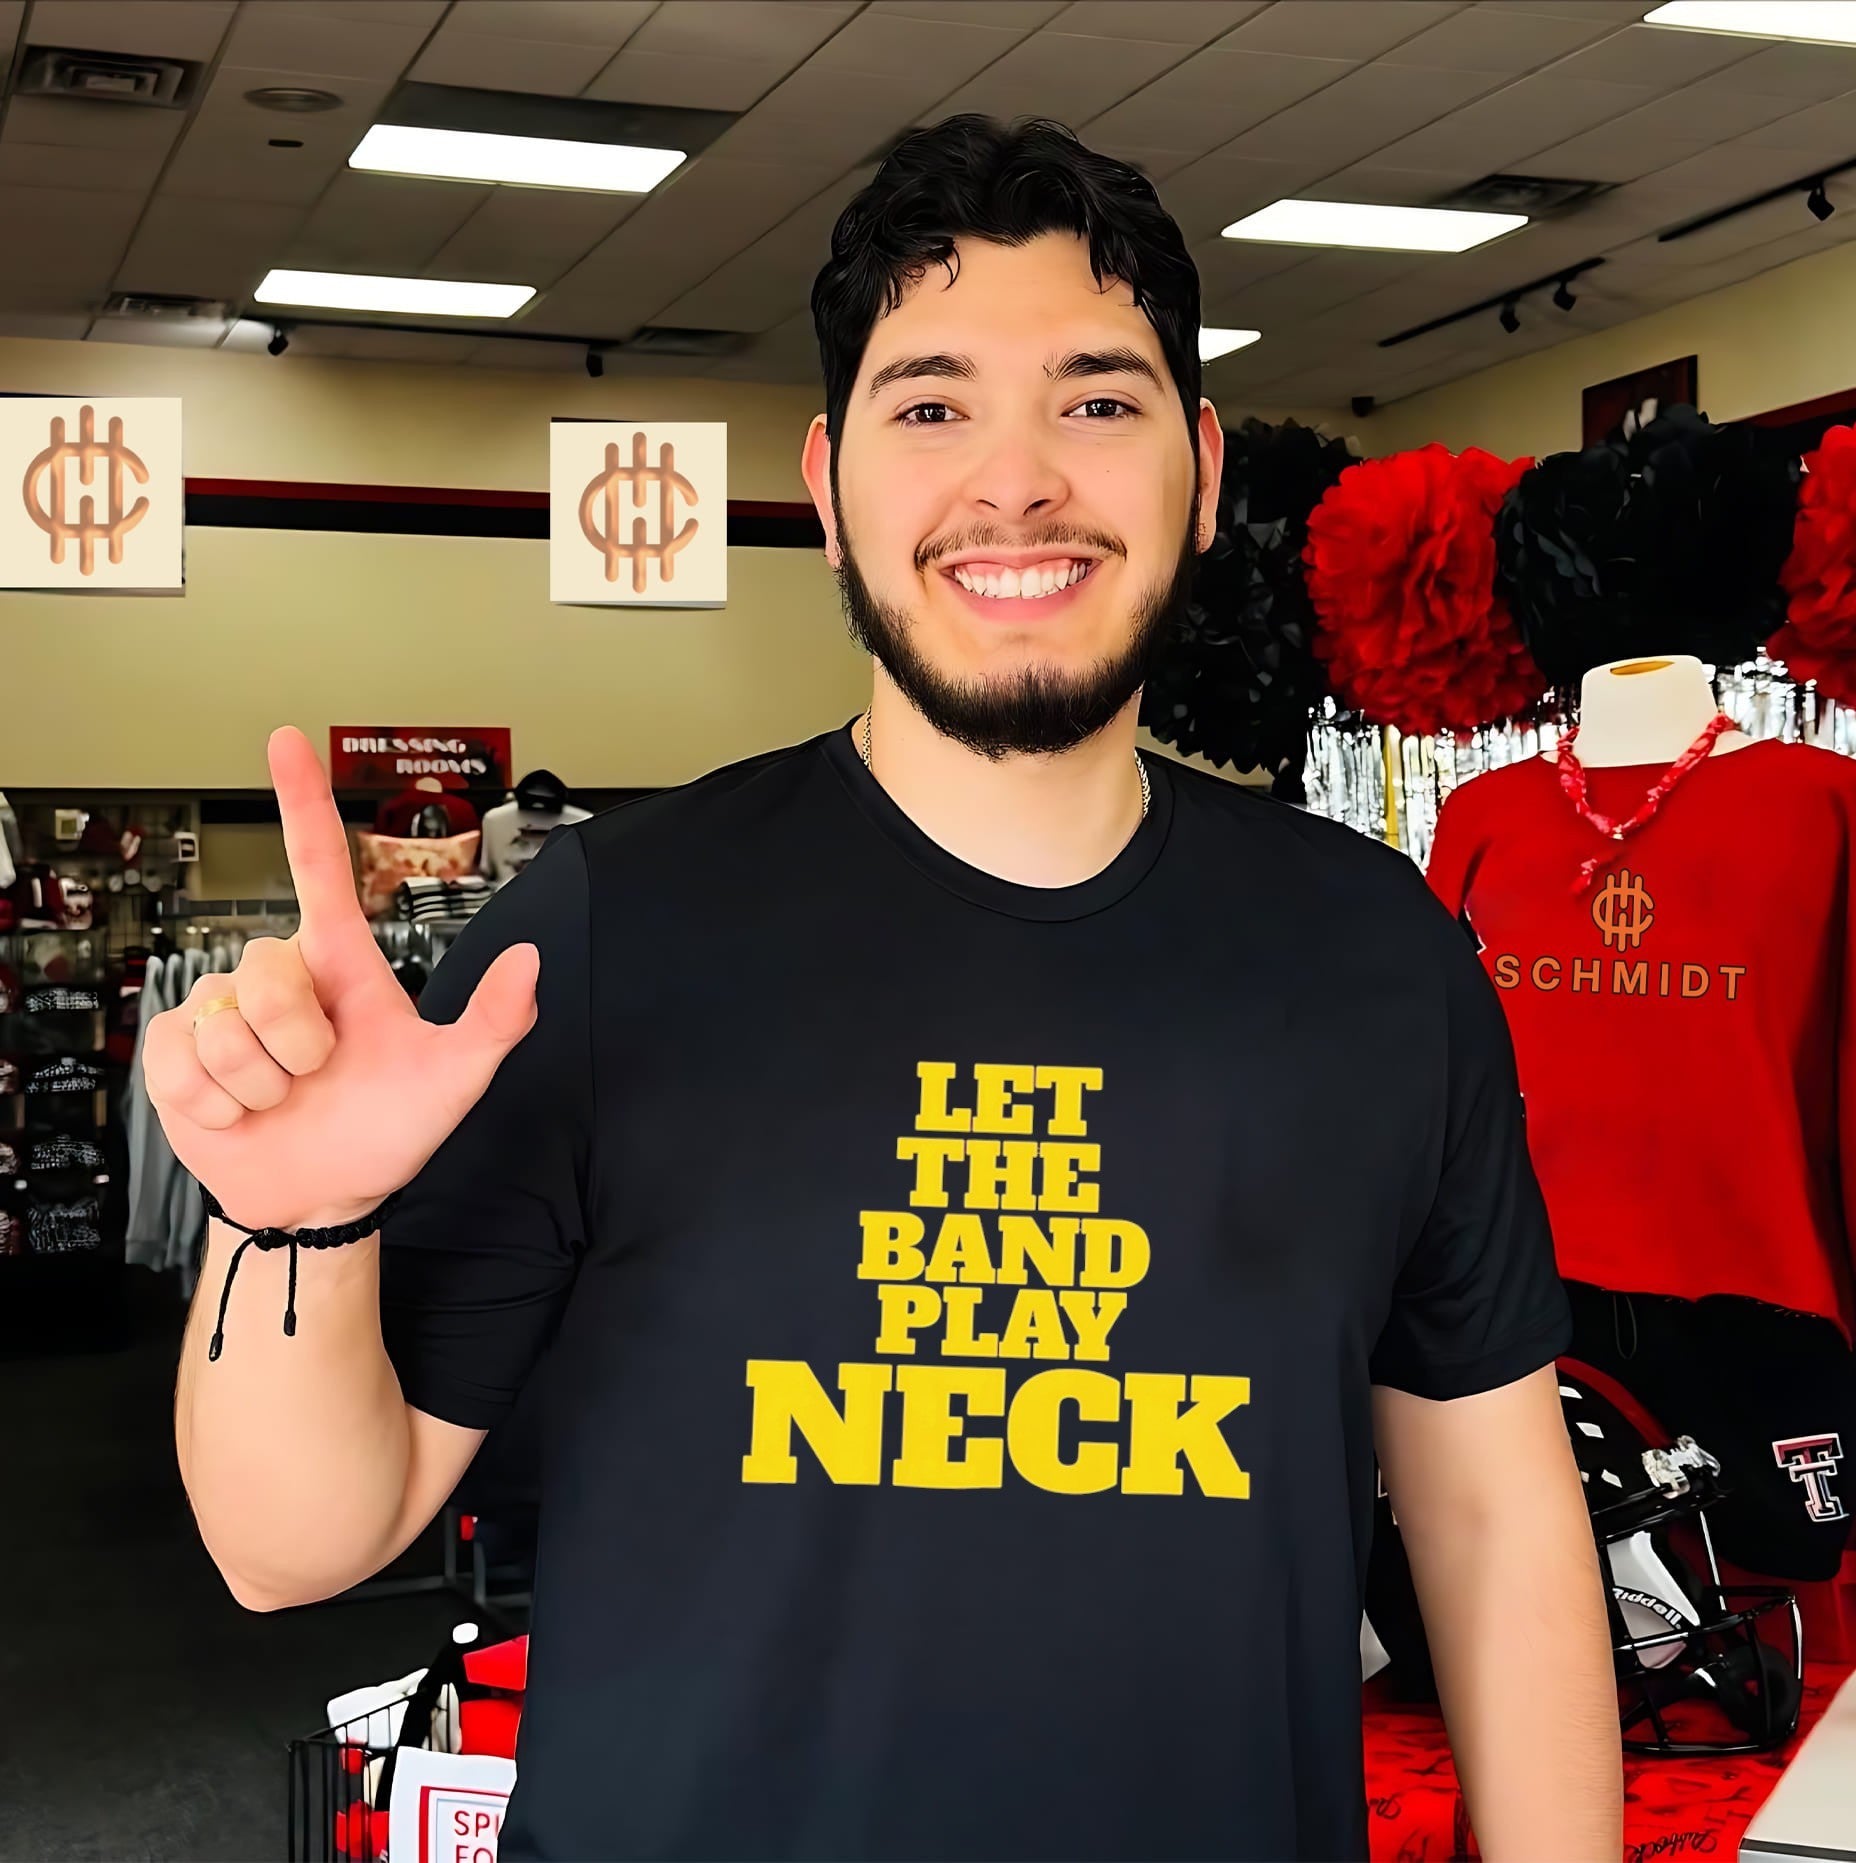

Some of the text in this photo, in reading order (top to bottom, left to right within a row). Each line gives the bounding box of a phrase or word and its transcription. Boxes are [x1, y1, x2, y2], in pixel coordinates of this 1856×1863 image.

[342, 738, 467, 753] DRESSING
[396, 759, 487, 775] ROOMS
[1494, 954, 1746, 1000] SCHMIDT
[915, 1062, 1103, 1136] LET
[896, 1137, 1101, 1213] THE
[857, 1211, 1151, 1288] BAND
[876, 1284, 1128, 1361] PLAY
[742, 1360, 1251, 1499] NECK
